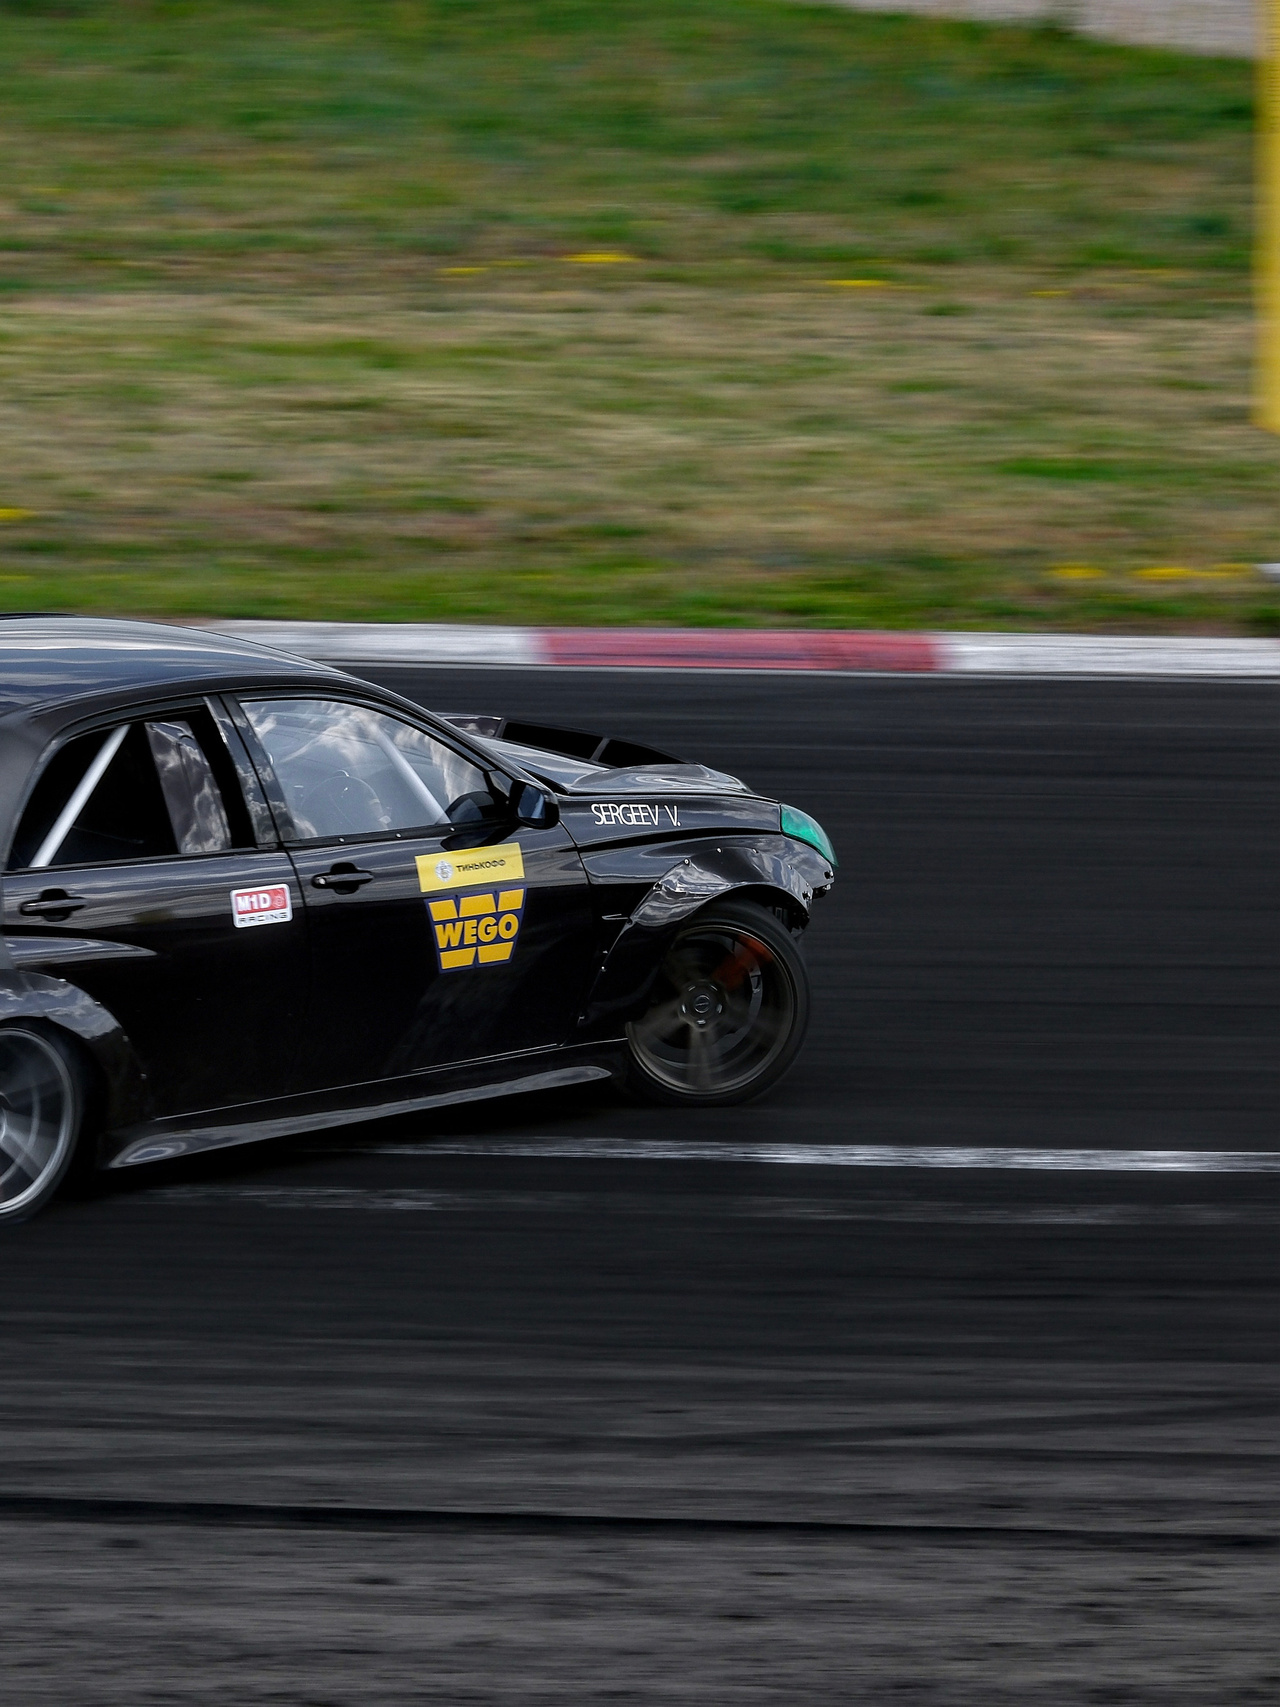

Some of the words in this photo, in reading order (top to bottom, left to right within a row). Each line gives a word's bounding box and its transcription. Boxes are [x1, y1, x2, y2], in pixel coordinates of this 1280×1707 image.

[591, 804, 659, 826] SERGEEV
[665, 805, 681, 826] V.
[456, 859, 506, 872] ТИНЬКОФФ
[238, 912, 287, 924] RACING
[435, 913, 519, 949] WEGO
